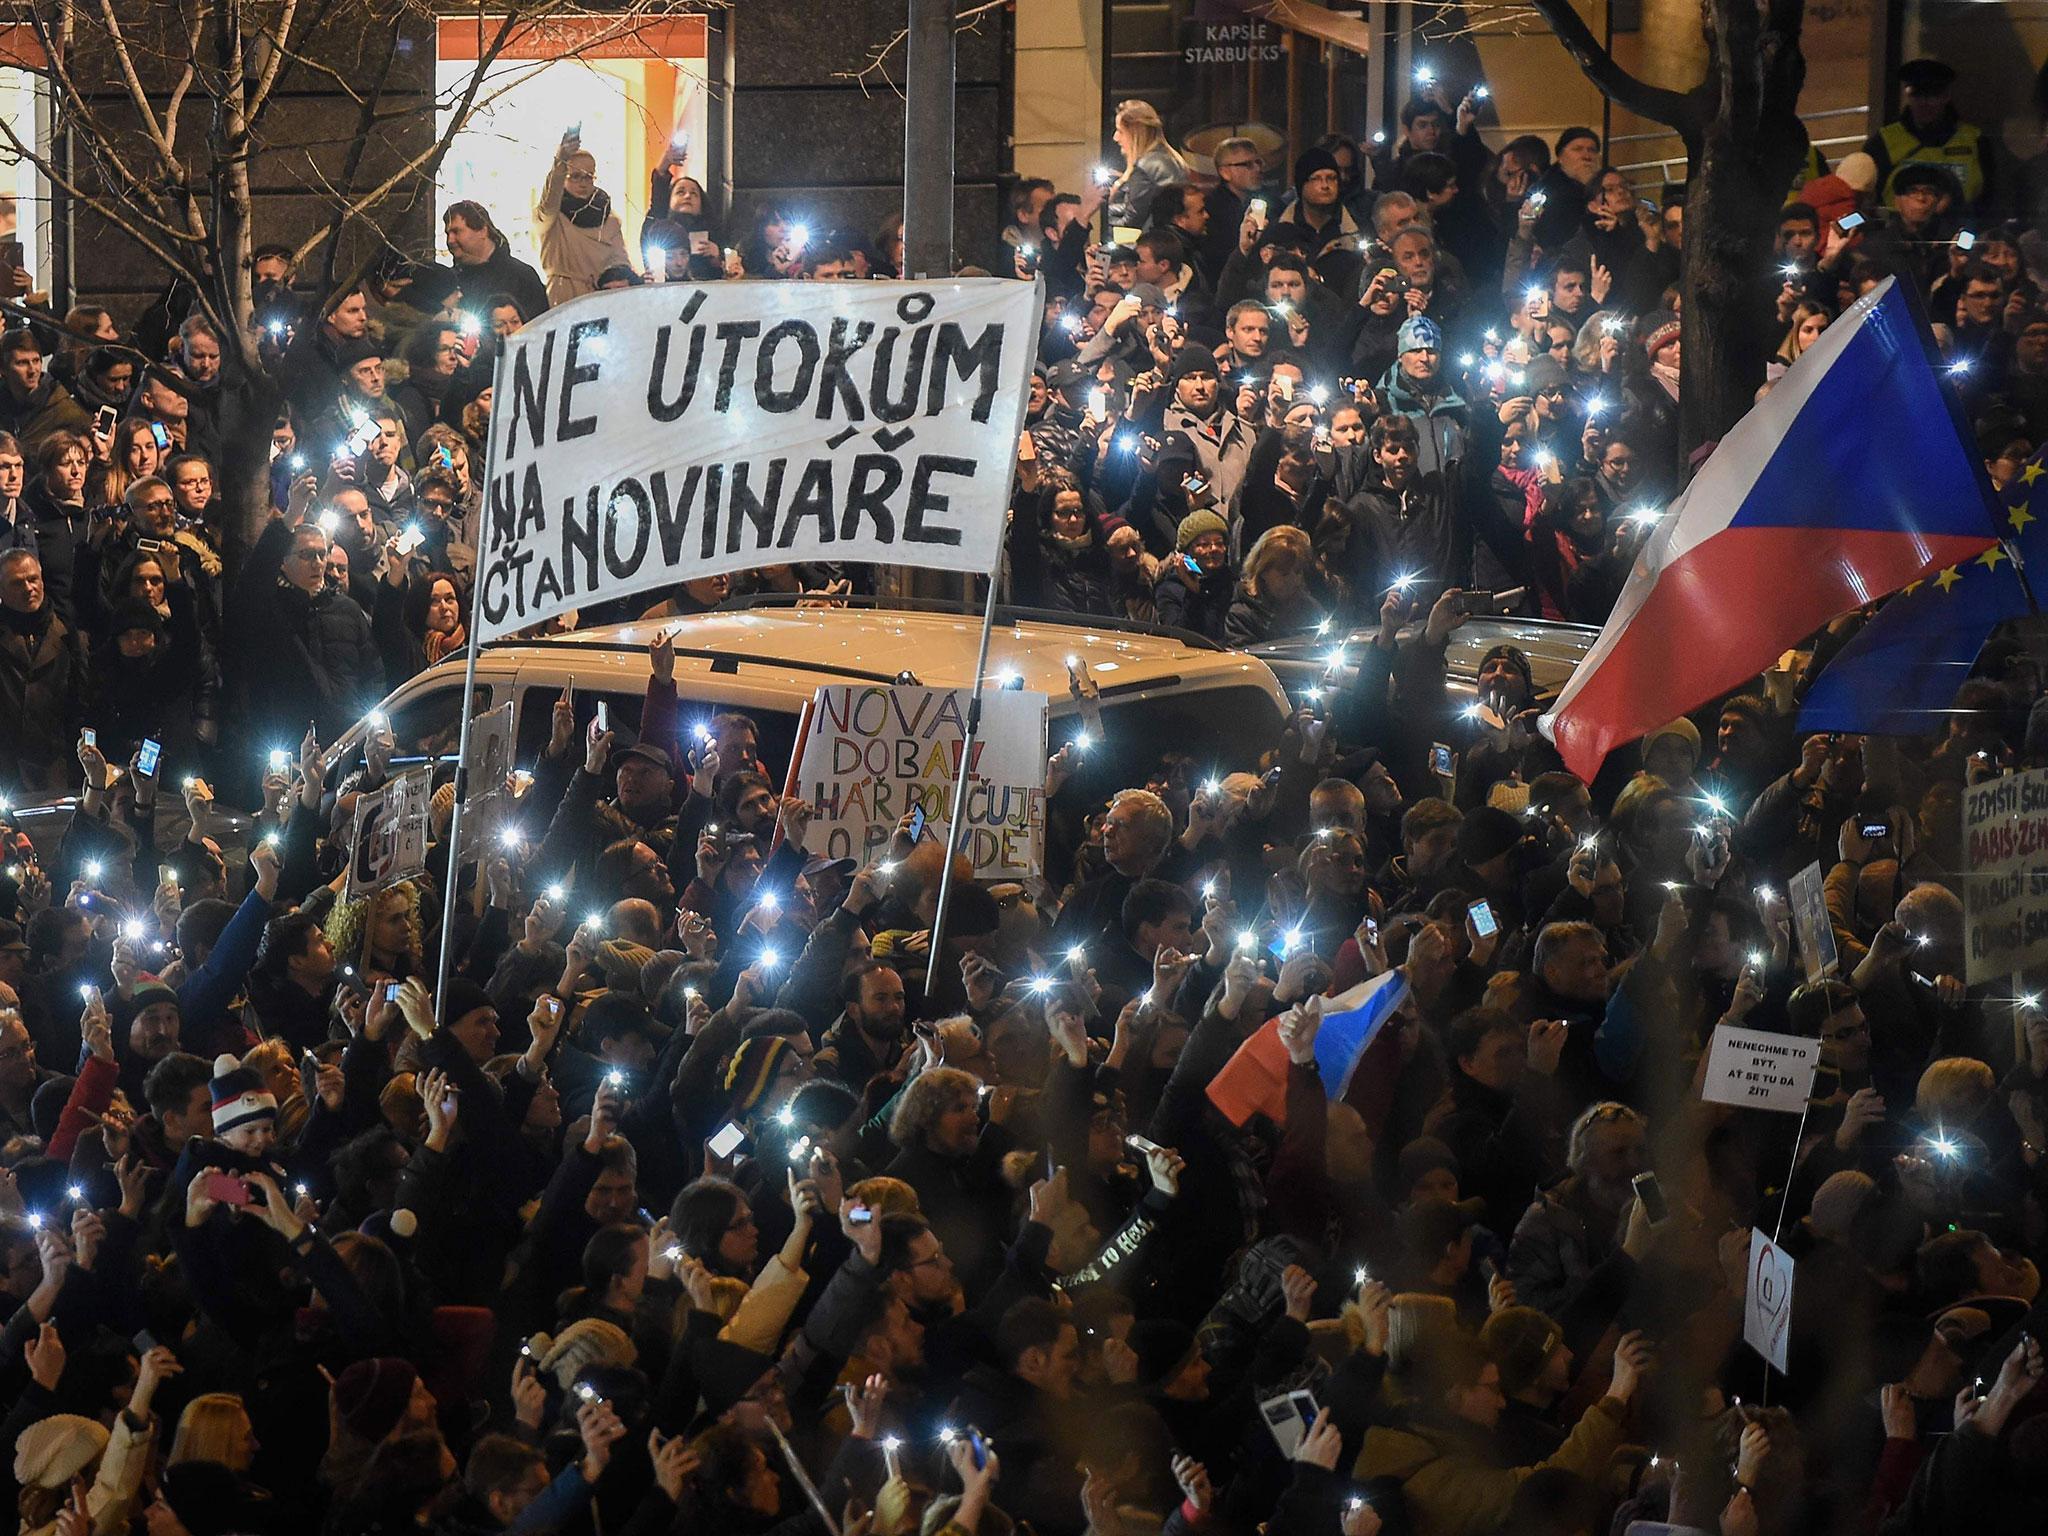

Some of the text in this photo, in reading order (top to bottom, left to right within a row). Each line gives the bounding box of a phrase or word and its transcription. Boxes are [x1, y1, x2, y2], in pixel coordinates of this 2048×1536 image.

[1206, 24, 1267, 41] KAPSLE
[507, 290, 1005, 460] NE ÚTOKŮM
[491, 461, 546, 553] NA
[561, 426, 978, 597] NOVINÁŘE
[817, 687, 967, 739] NOVÁ
[833, 736, 986, 782] DOBA!!
[828, 827, 850, 860] O
[1728, 1039, 1807, 1059] NENECHME TO
[1728, 1069, 1795, 1087] AŤ SE TU DÁ
